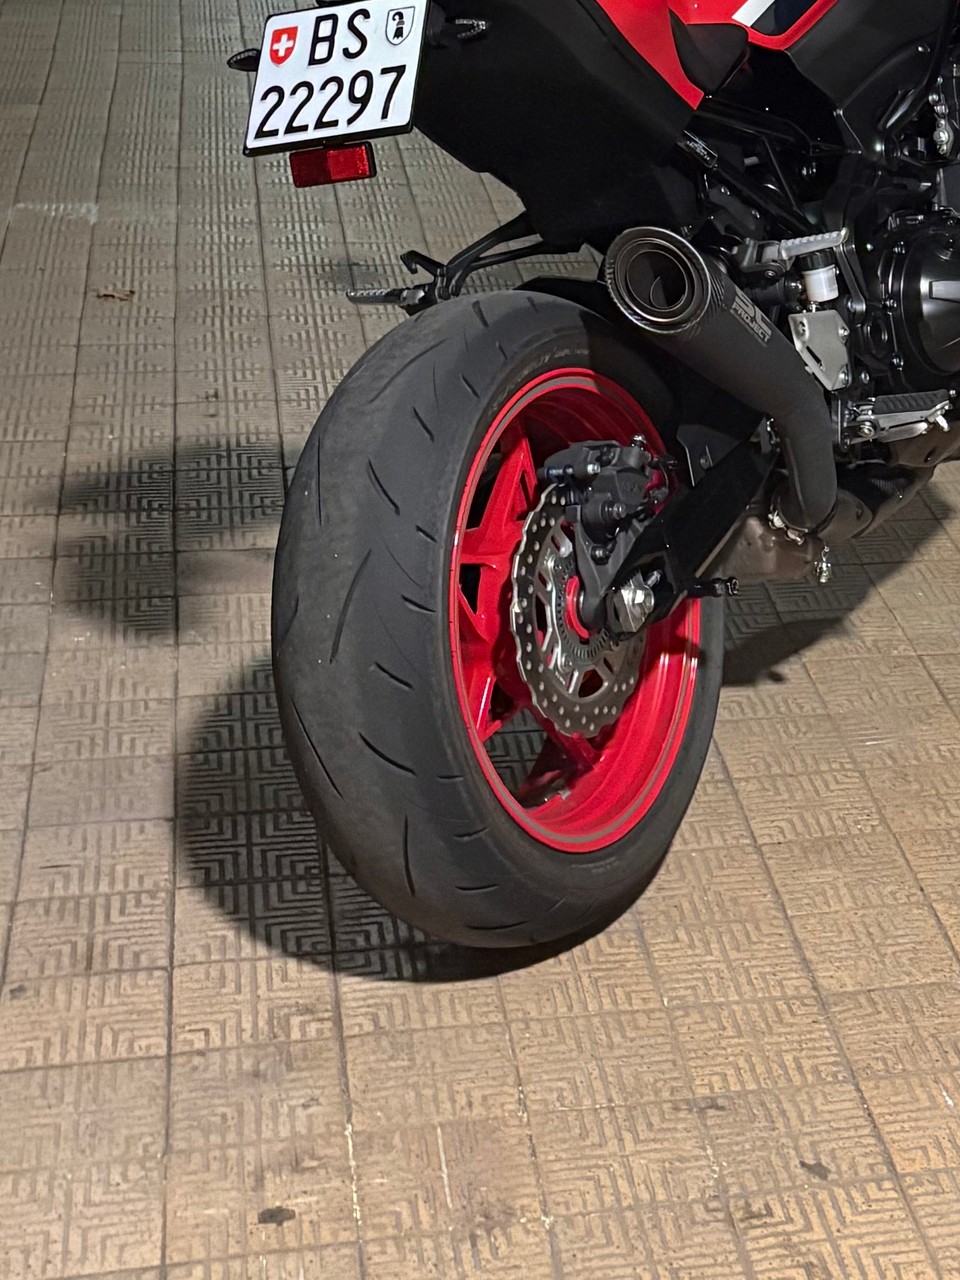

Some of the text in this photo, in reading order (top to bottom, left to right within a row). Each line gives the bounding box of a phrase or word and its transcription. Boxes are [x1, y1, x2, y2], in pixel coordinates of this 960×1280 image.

[308, 8, 371, 66] BS
[253, 64, 407, 139] 22297
[731, 301, 771, 343] PROJECT
